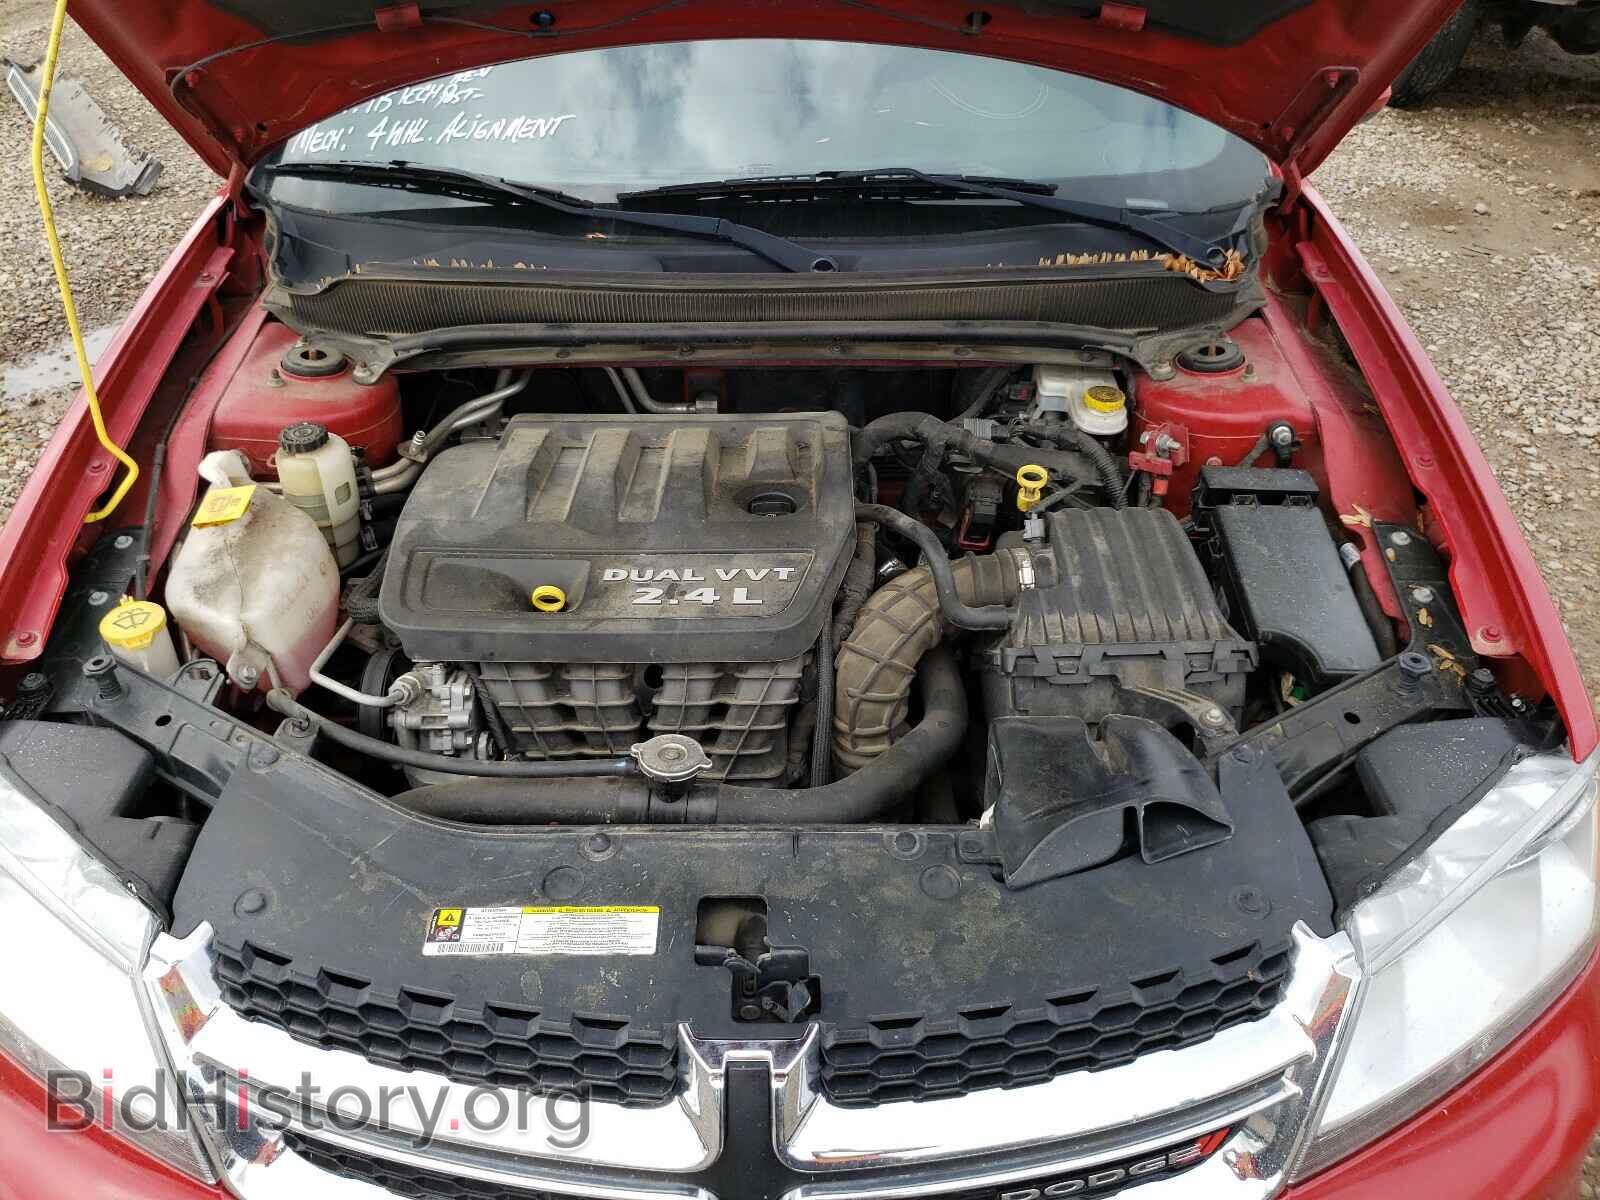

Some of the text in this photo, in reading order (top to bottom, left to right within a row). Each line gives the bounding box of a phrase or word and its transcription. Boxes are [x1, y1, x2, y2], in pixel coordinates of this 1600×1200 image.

[602, 567, 795, 582] DUAL VVT
[1001, 1144, 1201, 1200] DODGE
